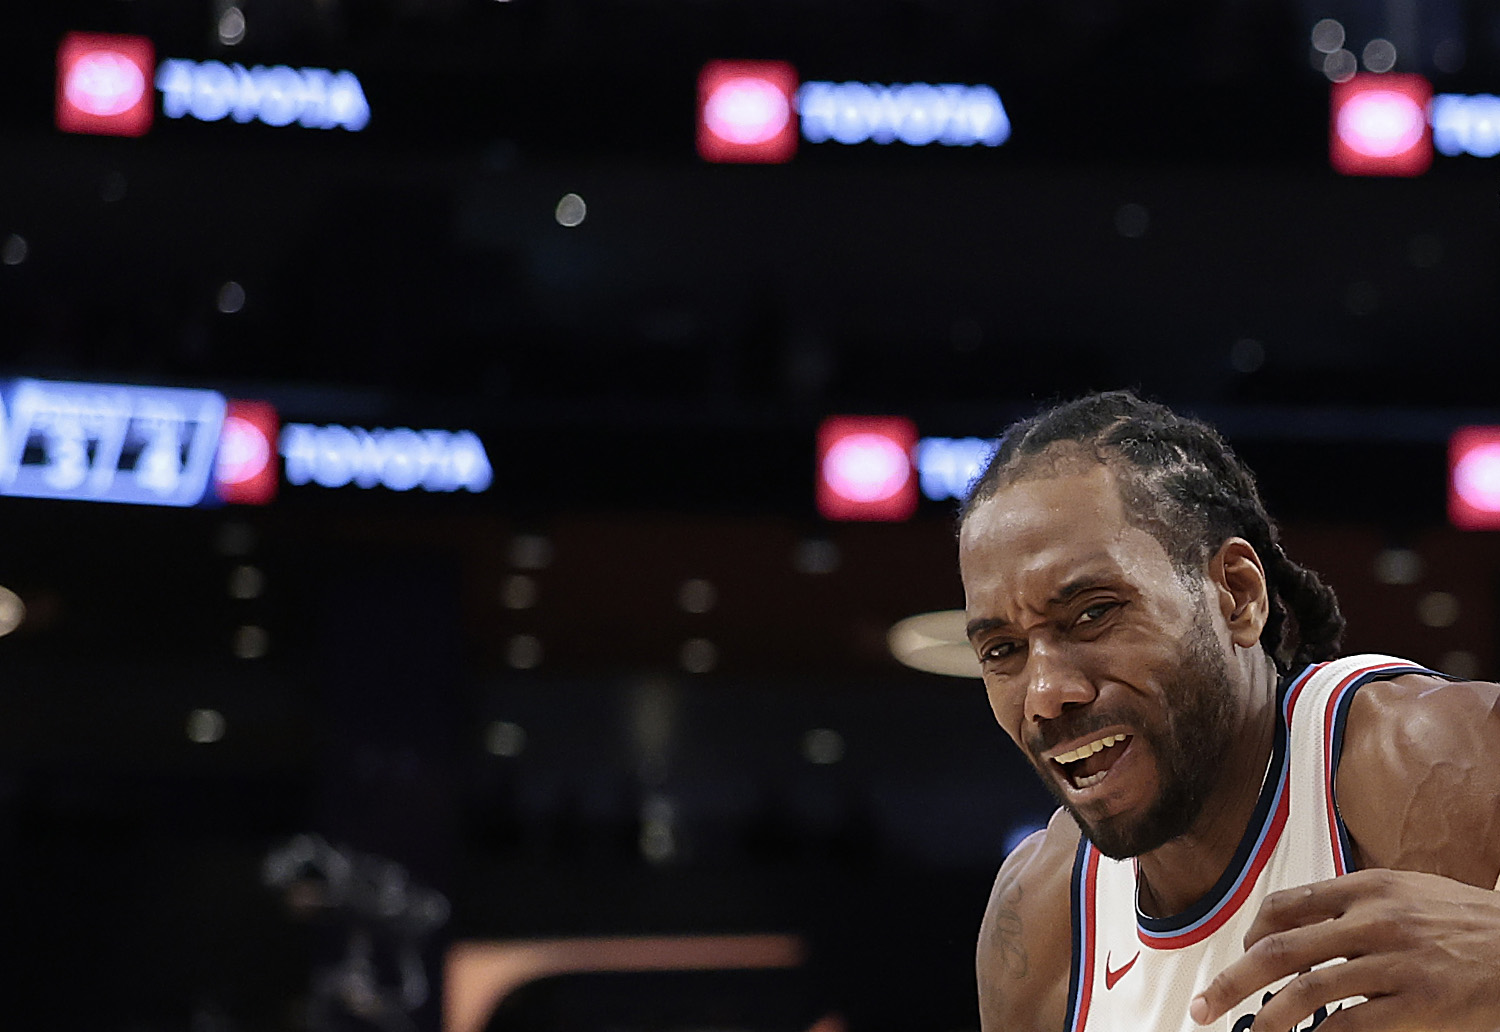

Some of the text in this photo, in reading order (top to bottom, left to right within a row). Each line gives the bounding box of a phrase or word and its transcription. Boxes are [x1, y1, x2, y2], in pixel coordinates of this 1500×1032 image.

[158, 60, 369, 131] TOYOTA
[797, 82, 1010, 146] TOYOTA
[281, 424, 492, 492] TOYOTA
